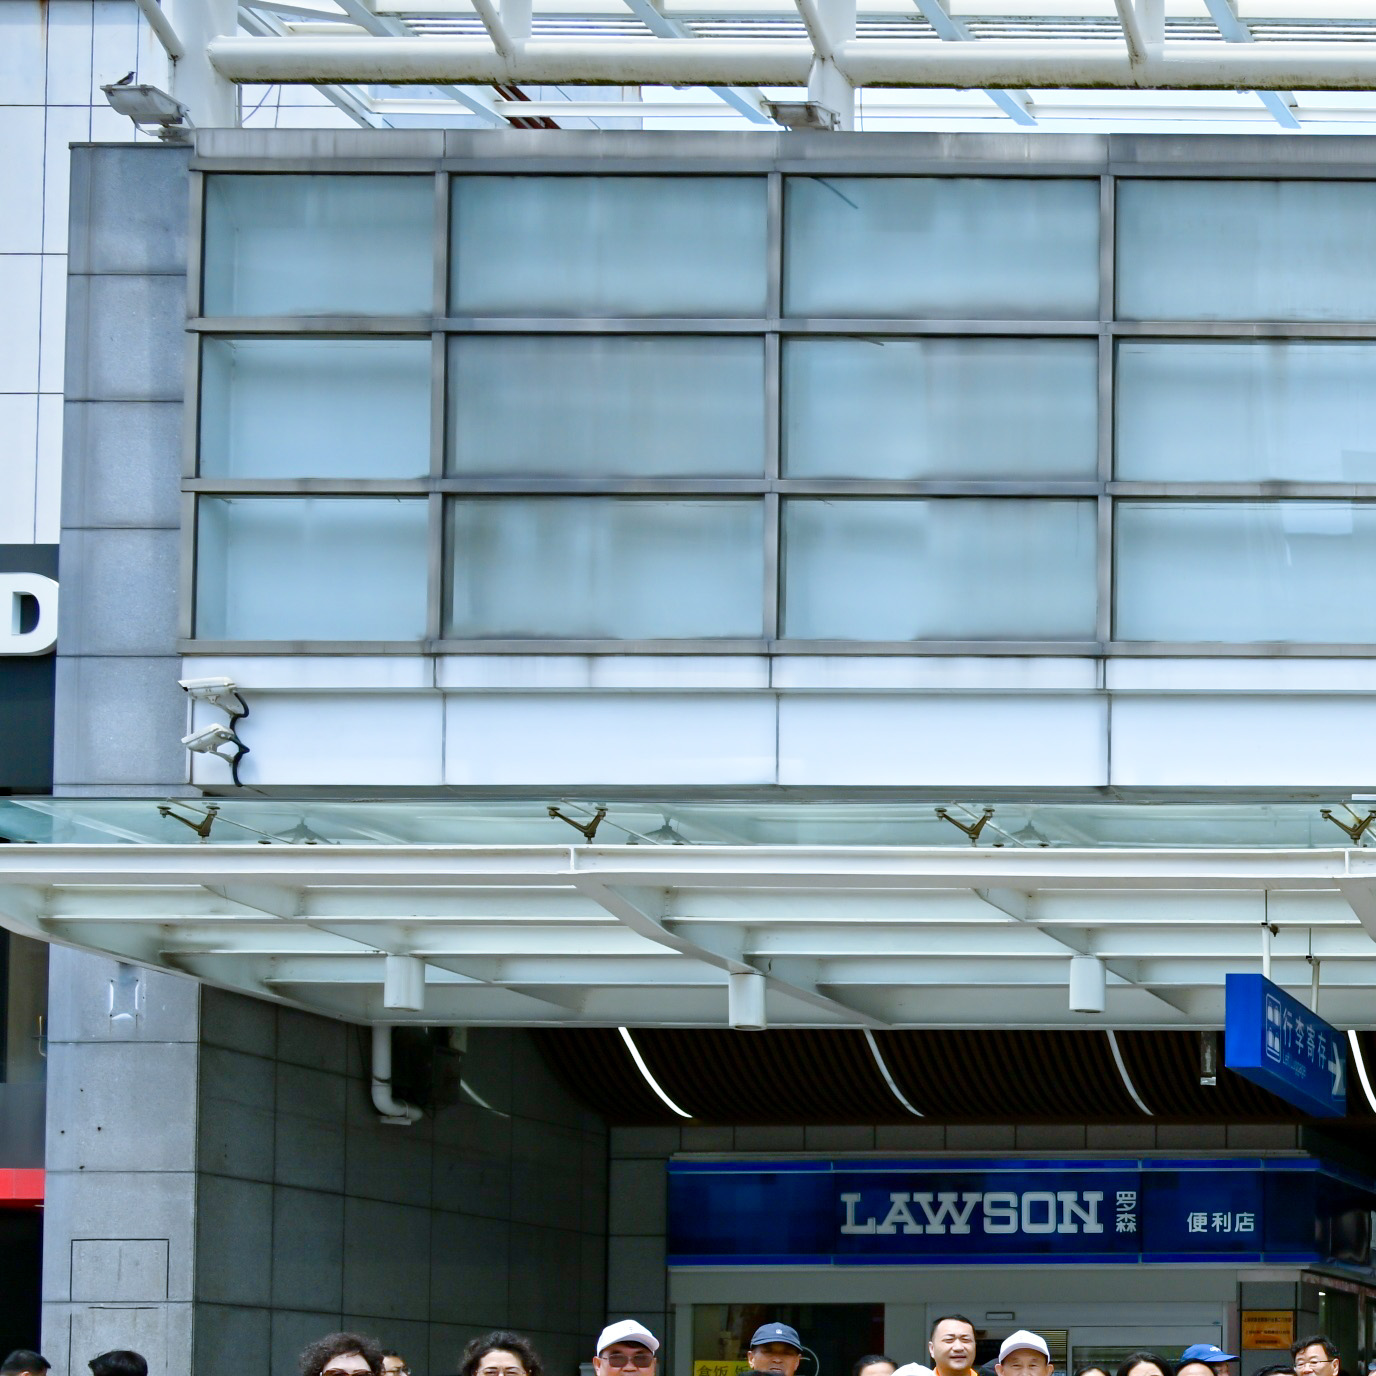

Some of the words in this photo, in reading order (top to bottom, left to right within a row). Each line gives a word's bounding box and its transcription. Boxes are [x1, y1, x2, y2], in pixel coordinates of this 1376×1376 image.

[1282, 1007, 1327, 1071] 行李寄存
[840, 1191, 1104, 1235] LAWSON
[1115, 1190, 1137, 1233] 罗森
[1186, 1211, 1255, 1233] 便利店
